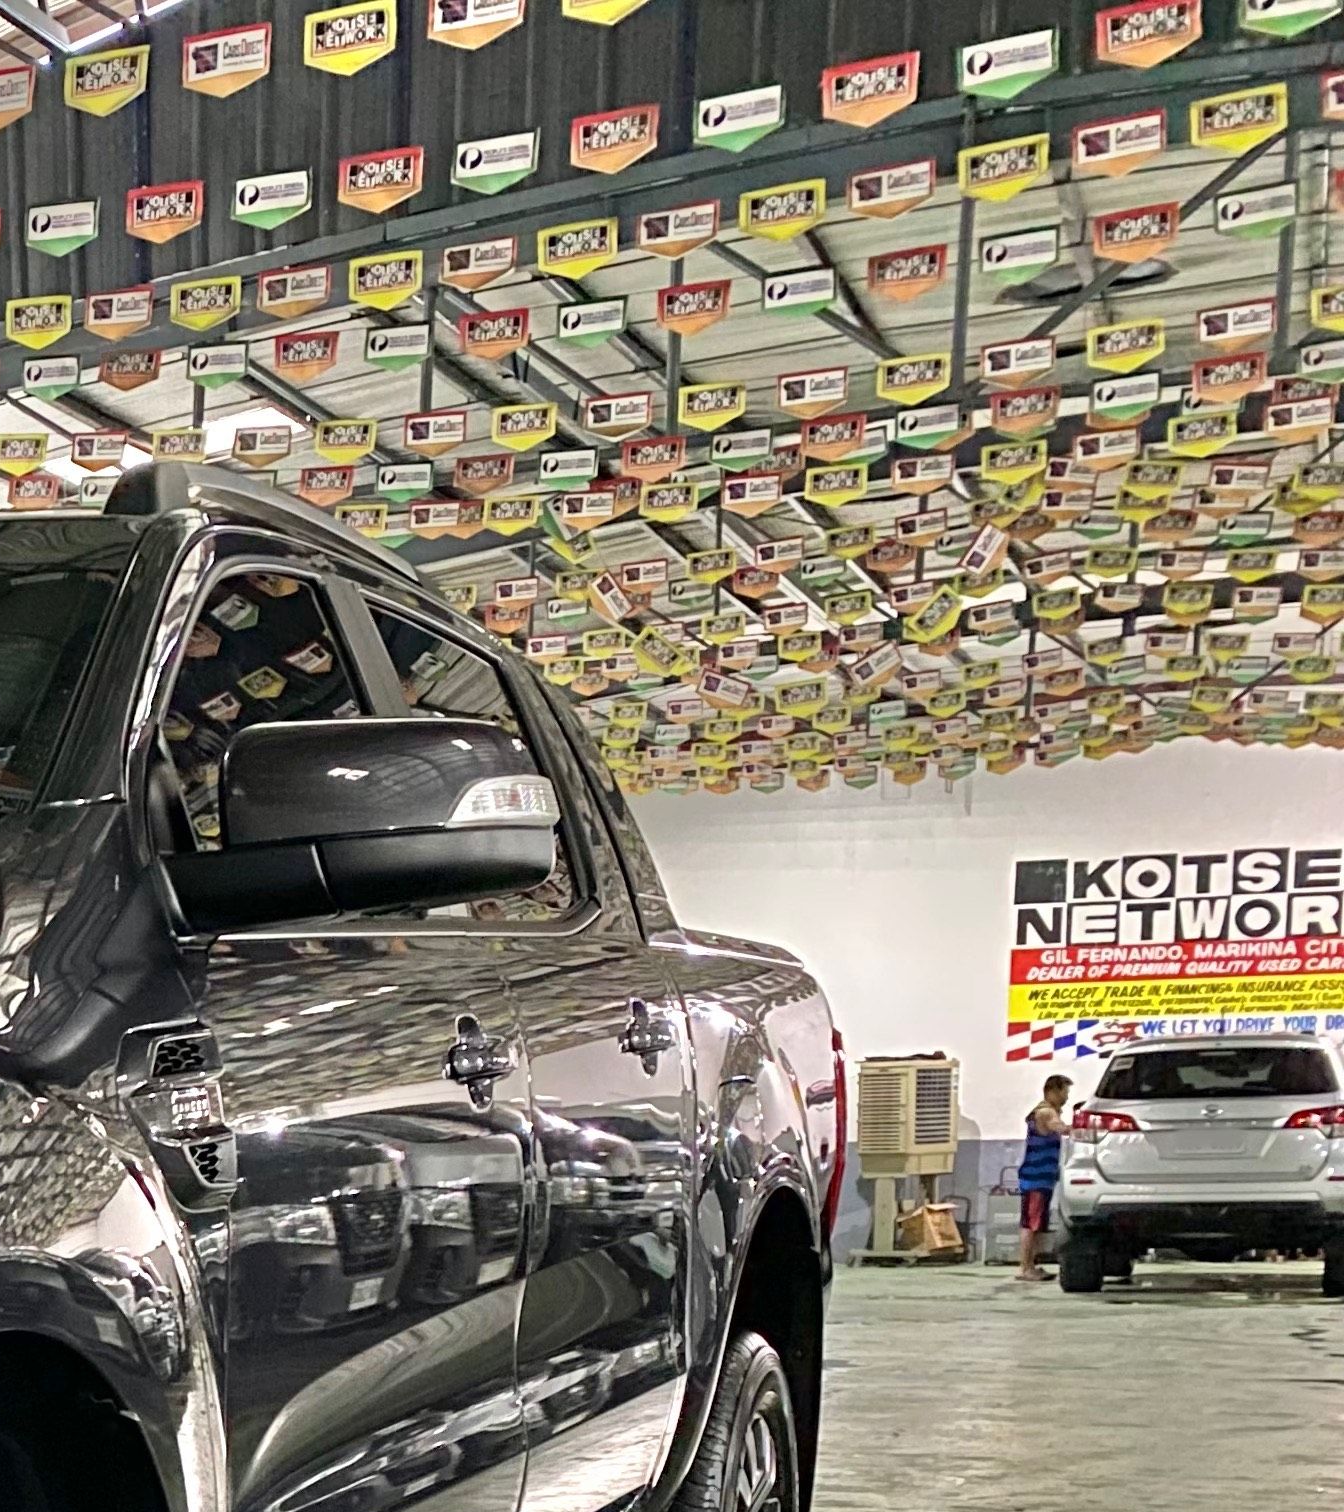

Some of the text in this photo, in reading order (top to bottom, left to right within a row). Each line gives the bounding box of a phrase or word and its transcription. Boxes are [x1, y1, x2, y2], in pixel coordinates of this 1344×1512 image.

[1073, 848, 1343, 899] KOTSE
[1016, 892, 1344, 945] NETWOR
[1040, 950, 1072, 965] GIL
[1194, 941, 1297, 959] MARIKINA
[1305, 939, 1344, 955] CIT
[1026, 956, 1344, 981] DEALER OF PREMIUM QUALITY USED CAR
[1028, 989, 1050, 1001] WE
[1051, 986, 1099, 1000] ACCEPT
[1103, 985, 1146, 998] TRADE
[1147, 985, 1162, 997] IN
[1236, 980, 1308, 993] INSURANCE
[1142, 1020, 1167, 1034] WE
[1172, 1019, 1199, 1034] LET
[1204, 1018, 1231, 1033] YOU
[1236, 1017, 1275, 1031] DRIVE
[1283, 1015, 1317, 1030] YOUR
